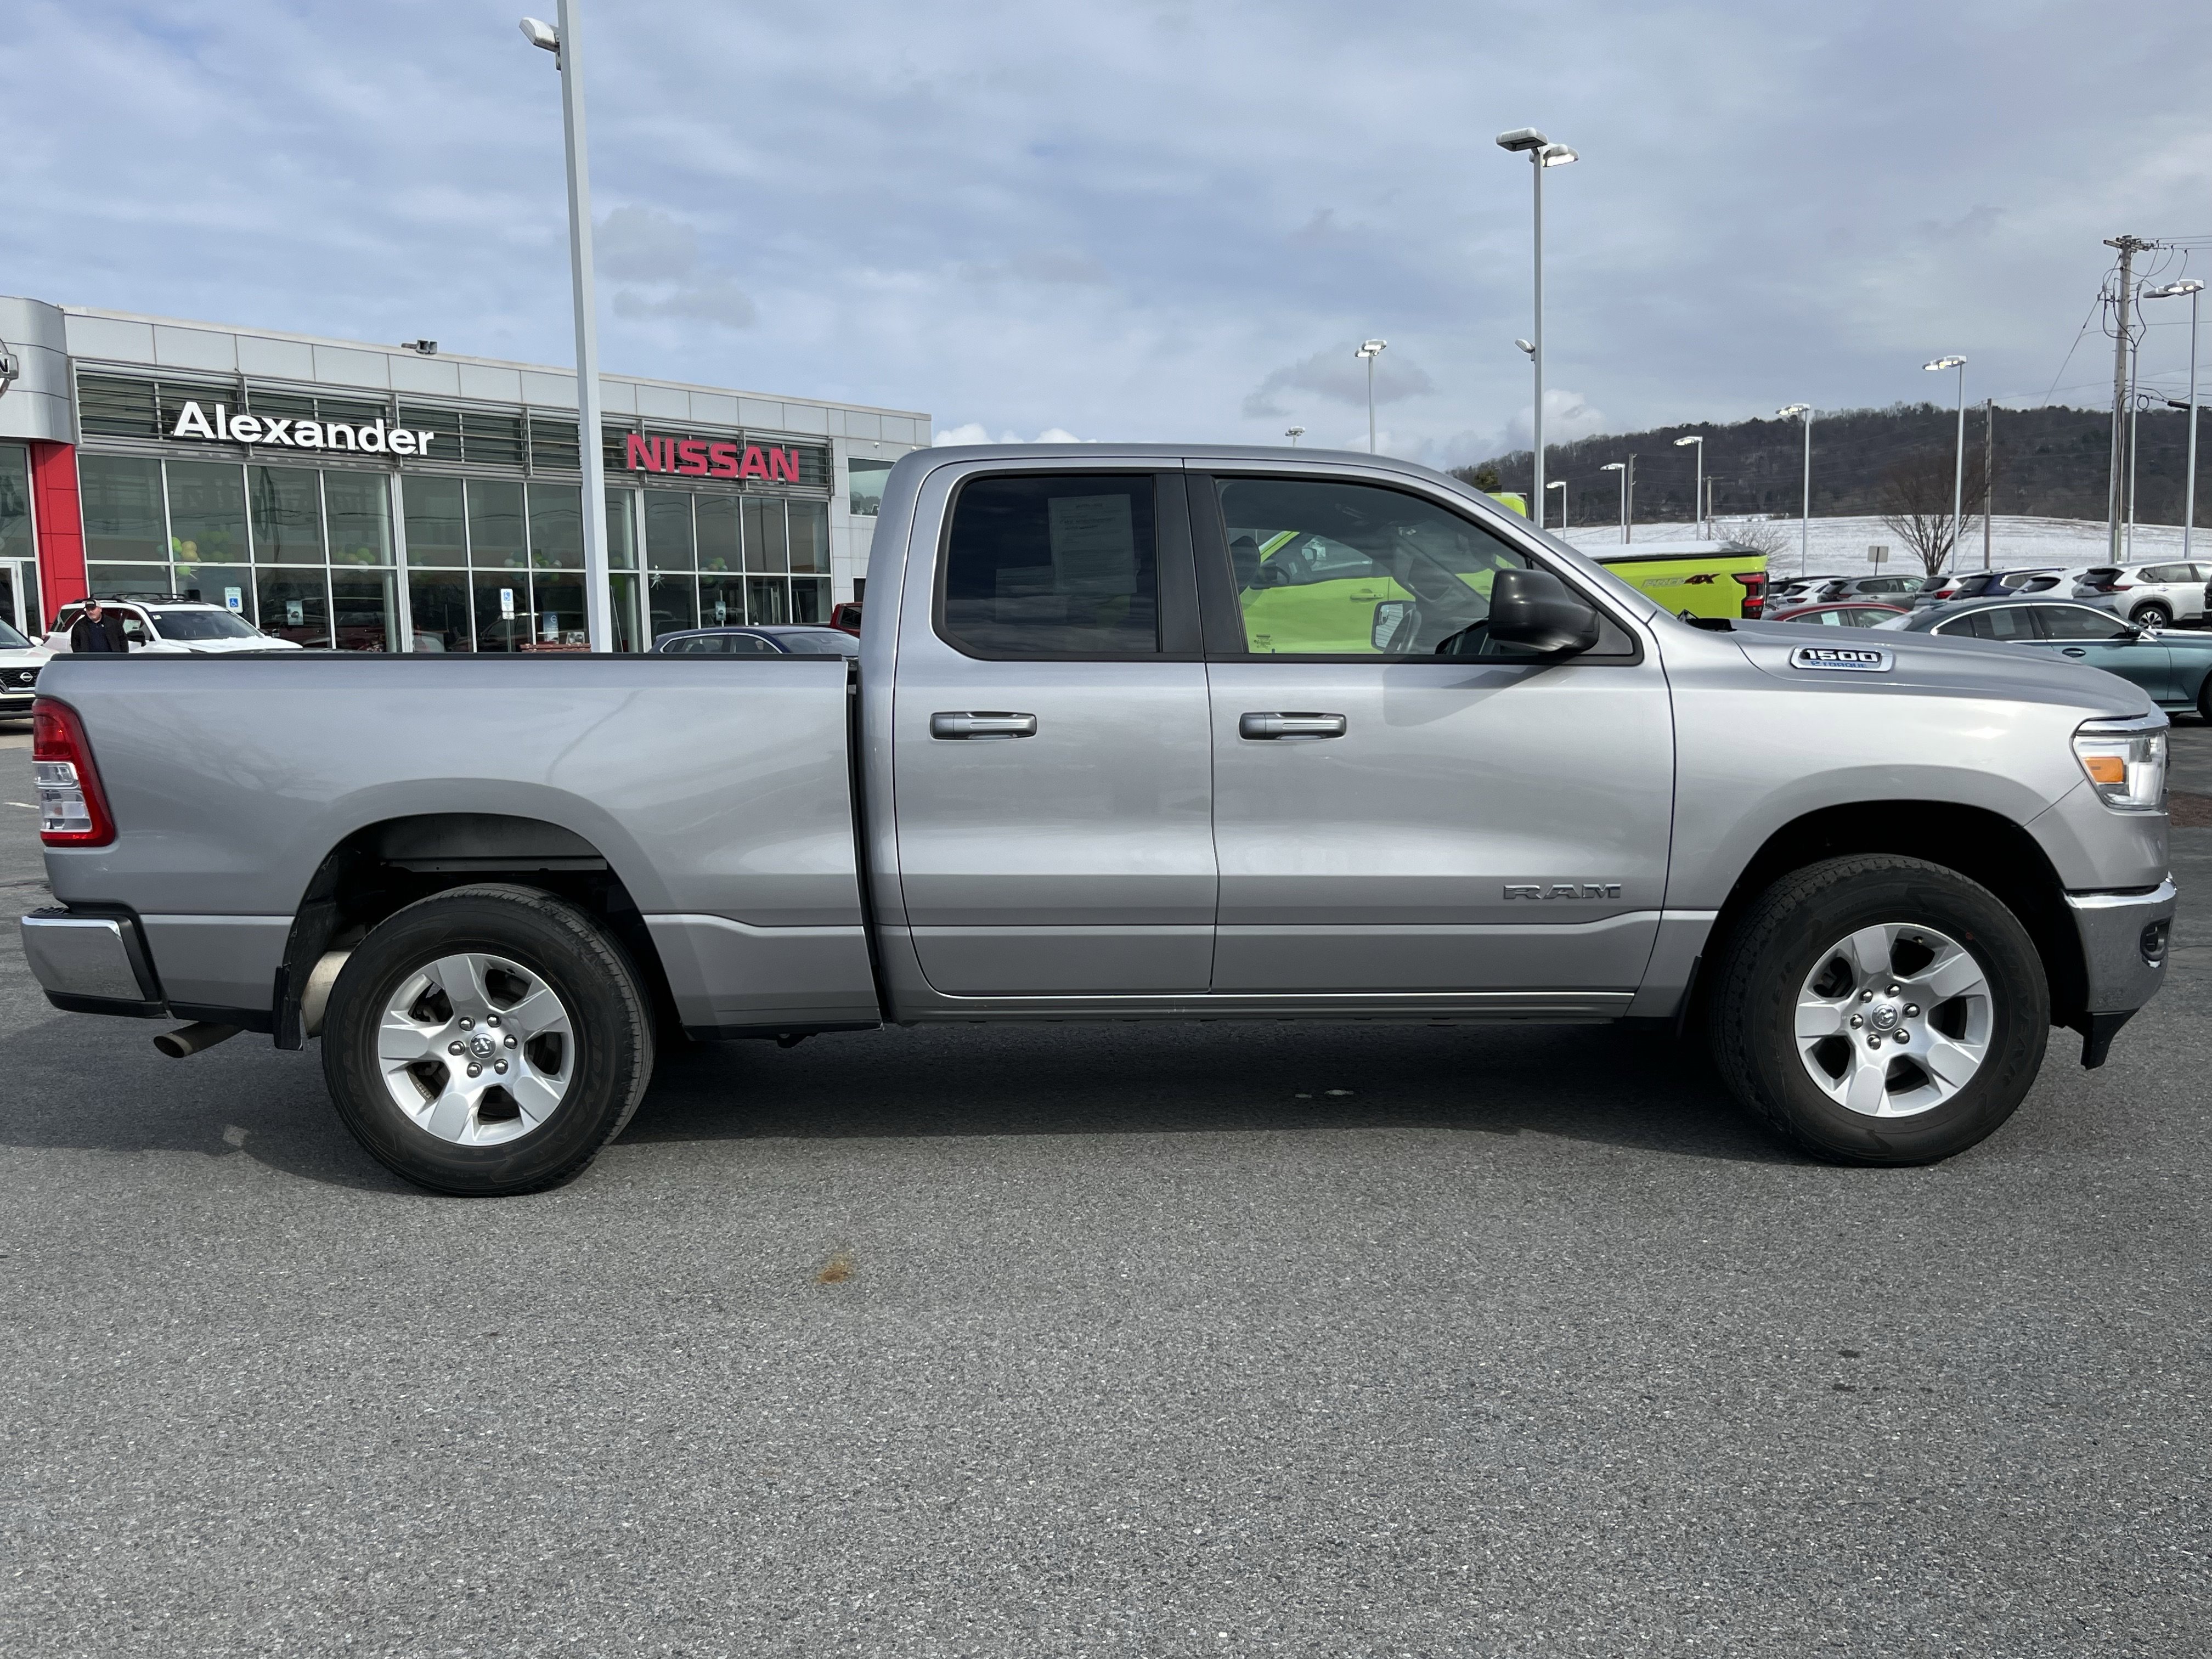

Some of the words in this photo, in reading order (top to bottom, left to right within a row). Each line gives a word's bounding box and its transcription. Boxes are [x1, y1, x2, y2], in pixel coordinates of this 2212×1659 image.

[173, 401, 435, 455] Alexander
[627, 433, 799, 483] NISSAN
[1807, 649, 1878, 662] 1500
[1504, 884, 1621, 900] RAM
